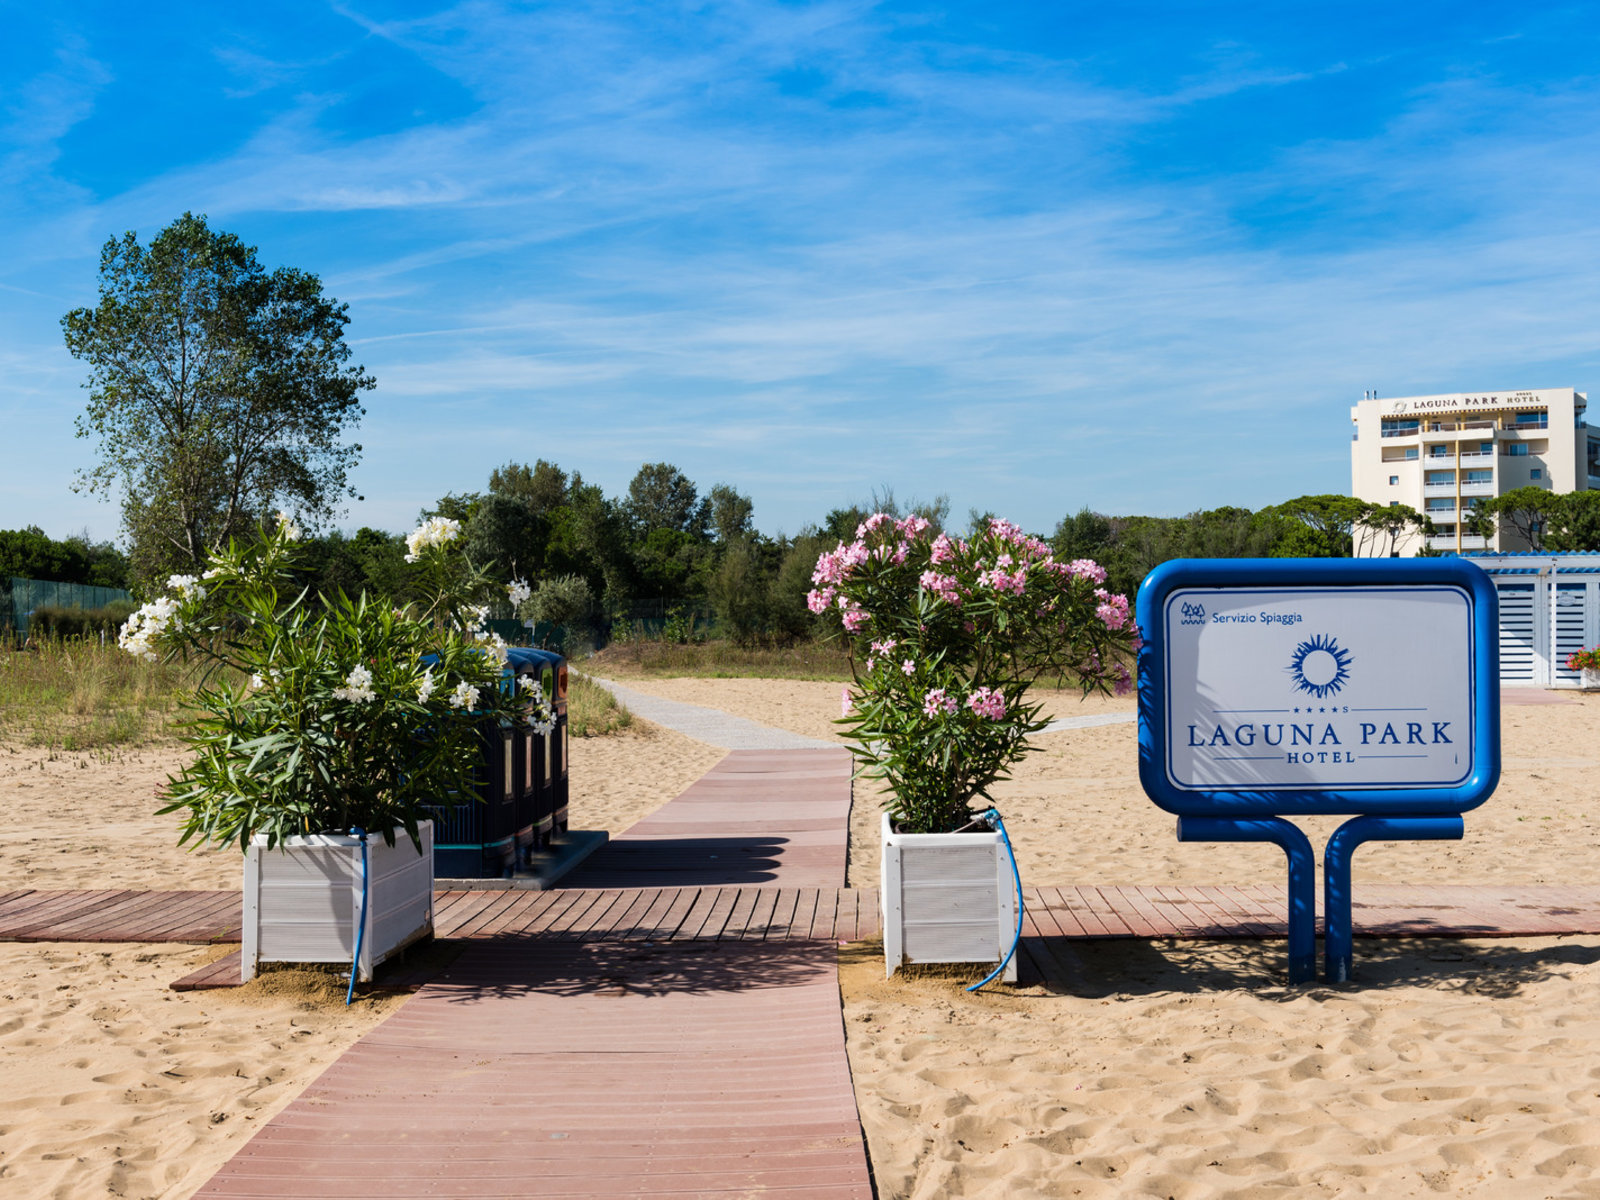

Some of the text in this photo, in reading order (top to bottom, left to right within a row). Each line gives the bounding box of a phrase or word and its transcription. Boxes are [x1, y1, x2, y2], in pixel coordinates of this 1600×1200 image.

[1414, 399, 1458, 409] LAGUNA
[1465, 397, 1499, 405] PARK
[1212, 611, 1303, 625] Servizio Spiaggia
[1187, 721, 1453, 746] LAGUNA PARK
[1287, 752, 1355, 764] HOTEL
